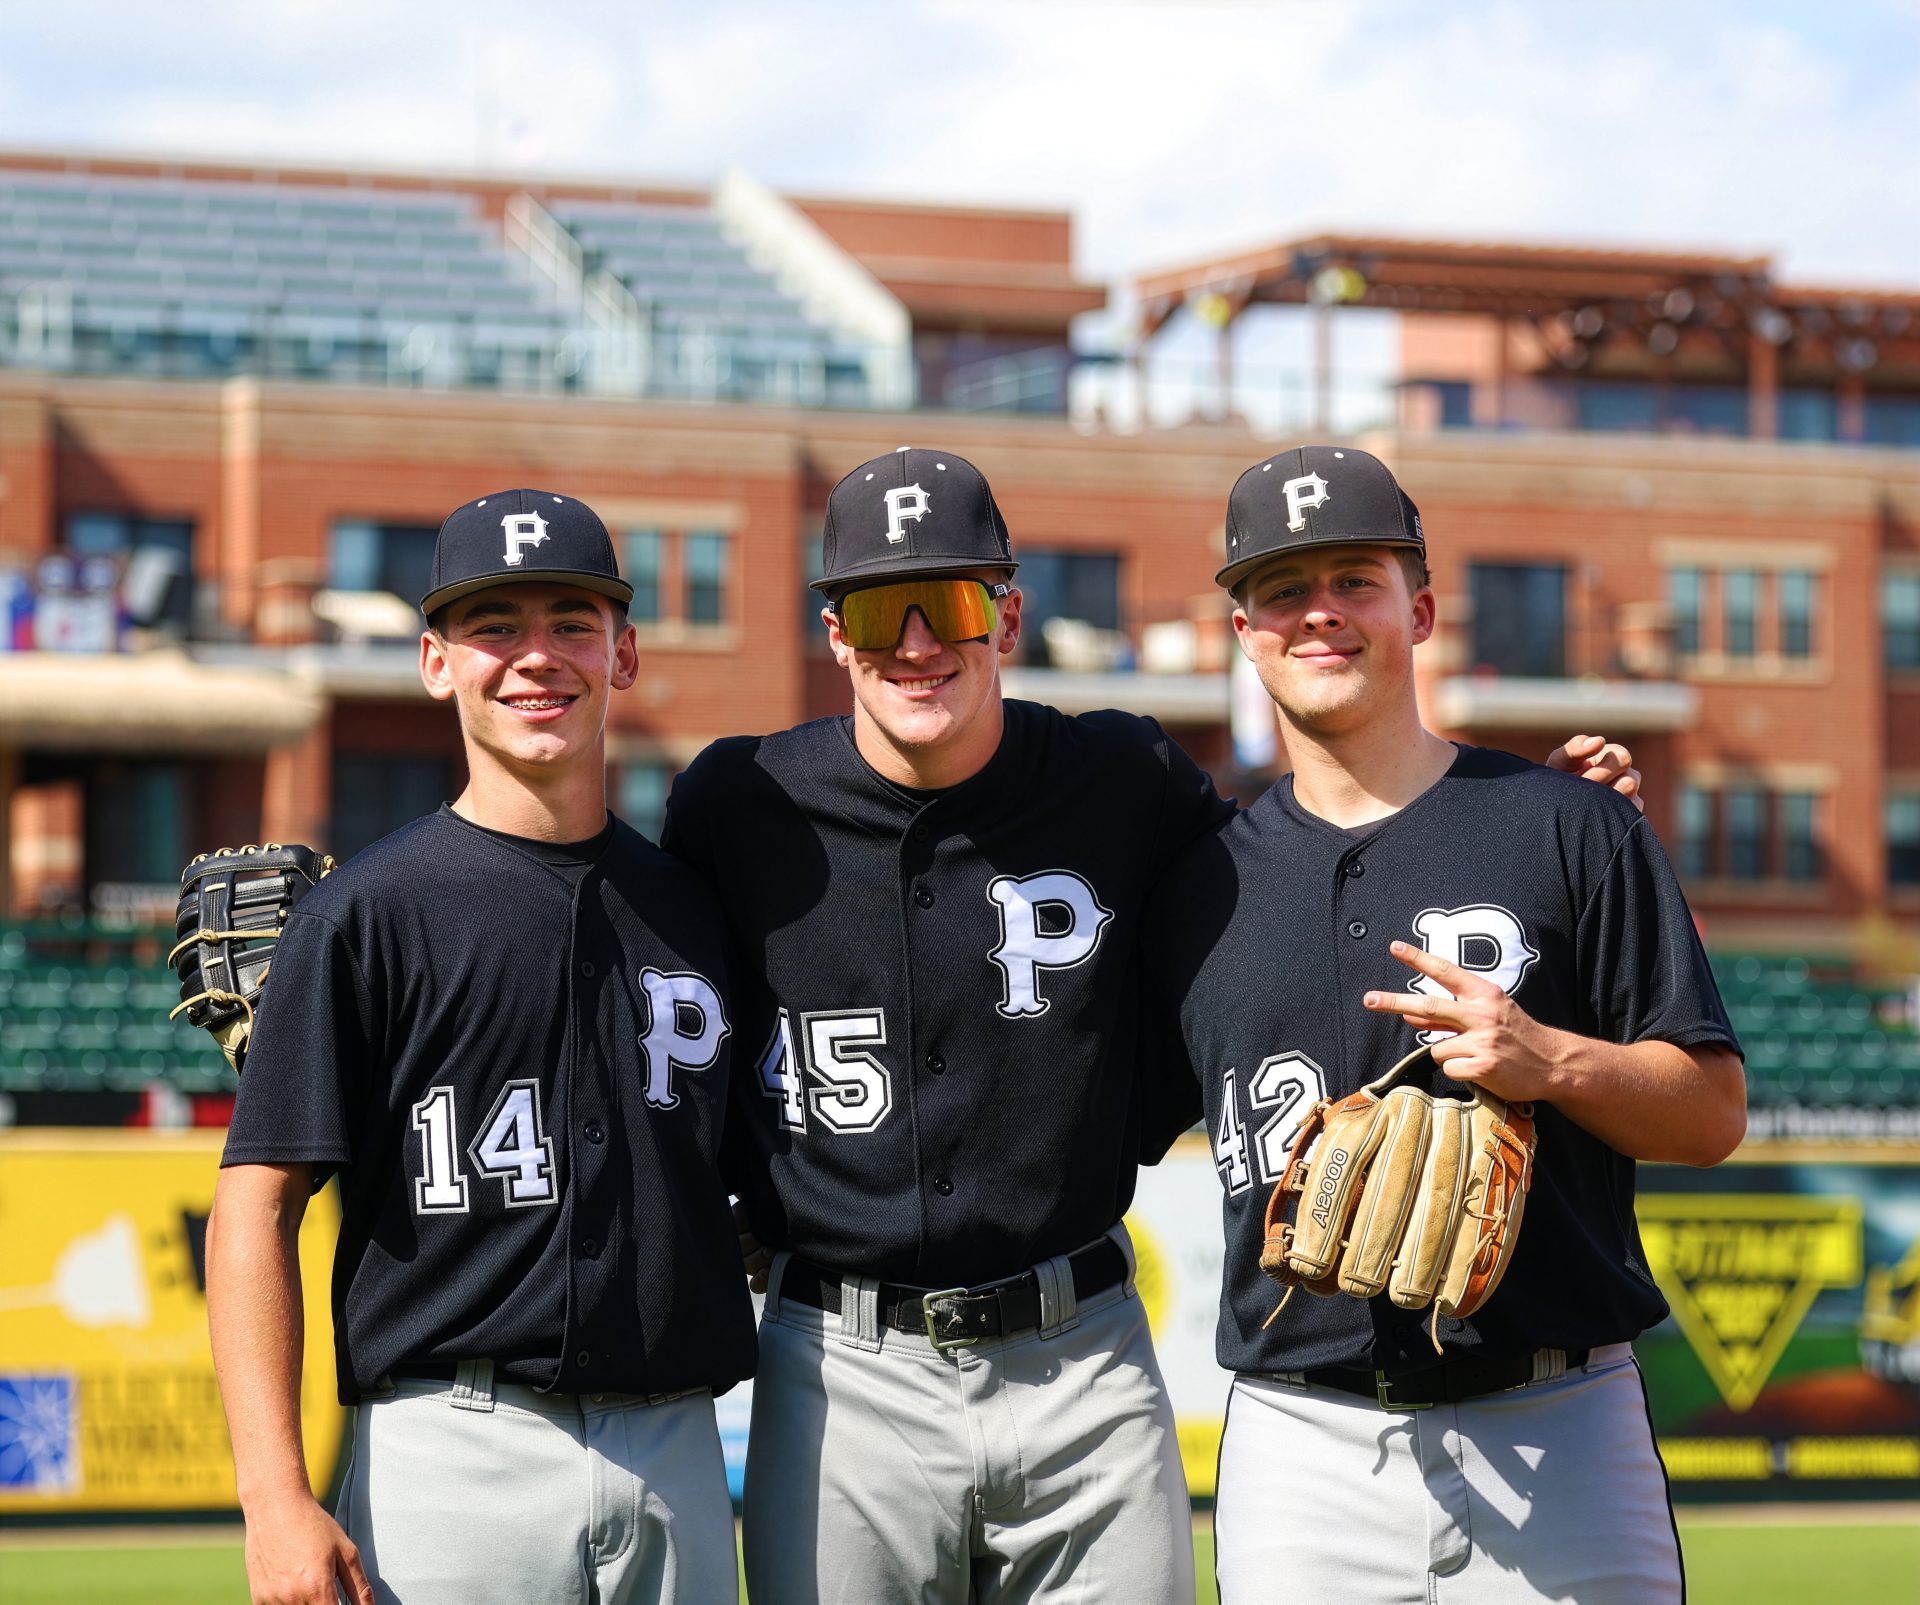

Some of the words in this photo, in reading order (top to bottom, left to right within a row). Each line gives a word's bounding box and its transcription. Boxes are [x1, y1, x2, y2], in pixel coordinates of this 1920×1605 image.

[500, 509, 551, 566] P
[883, 481, 932, 544] P
[1281, 470, 1331, 533] P
[986, 868, 1116, 1019] P
[1406, 903, 1541, 1047] P
[638, 965, 733, 1111] P
[754, 1006, 894, 1135] 45
[412, 1078, 559, 1216] 14
[1215, 1049, 1328, 1198] 42
[1312, 1148, 1348, 1229] A2000
